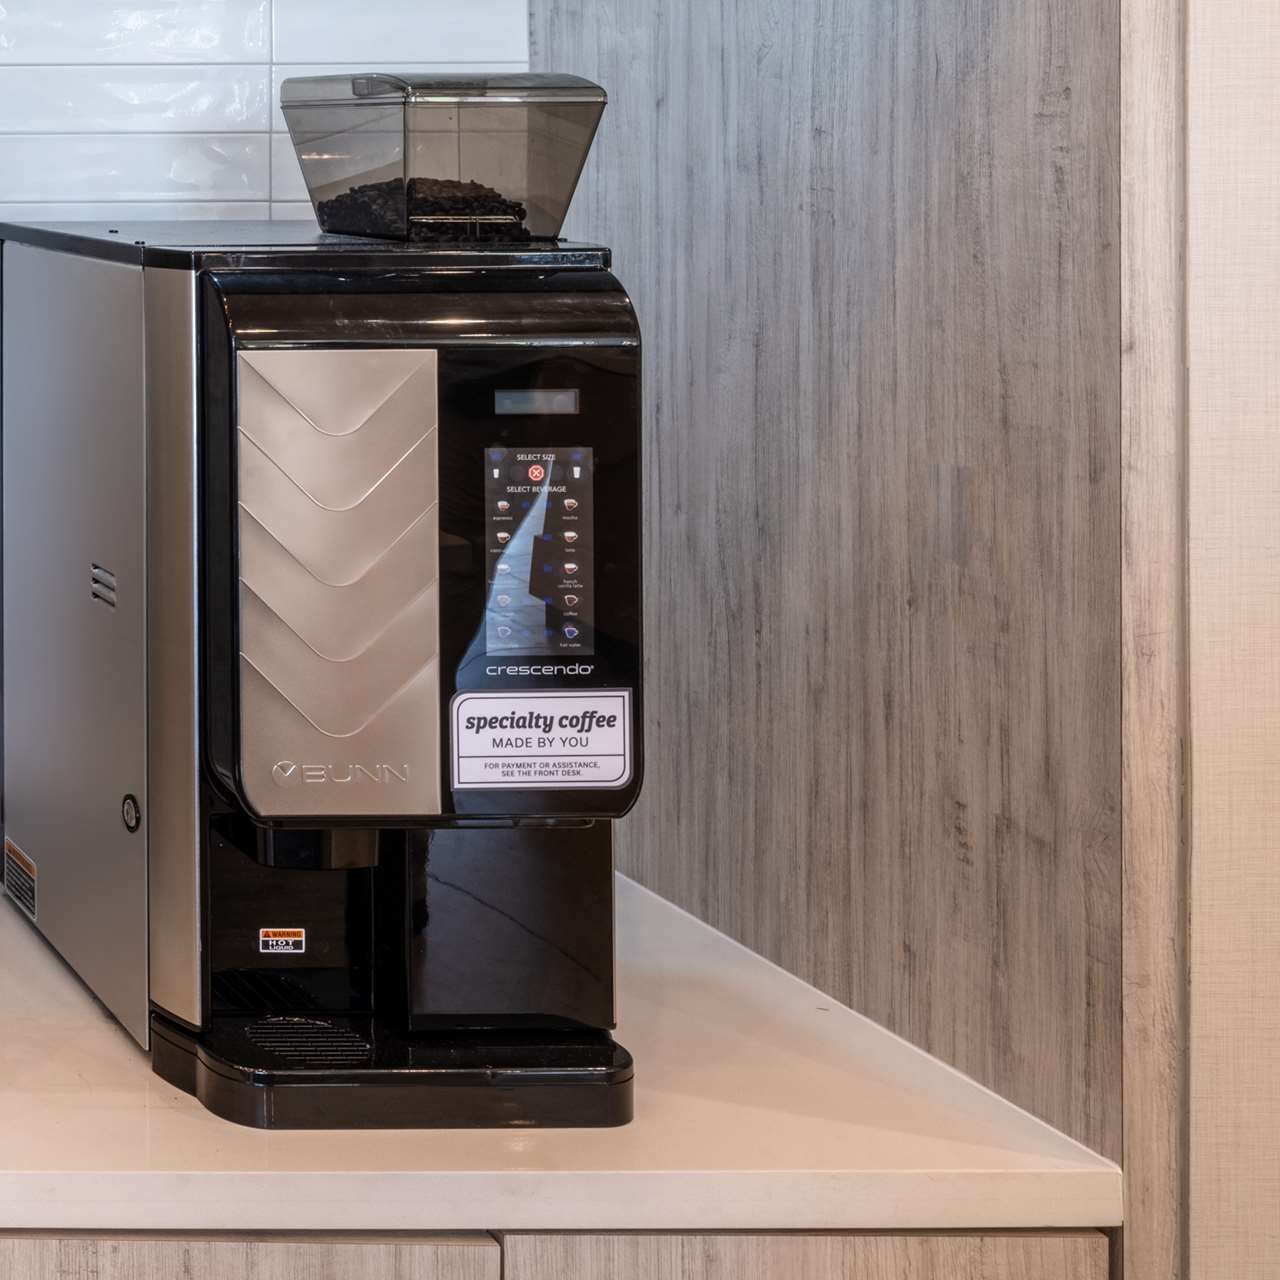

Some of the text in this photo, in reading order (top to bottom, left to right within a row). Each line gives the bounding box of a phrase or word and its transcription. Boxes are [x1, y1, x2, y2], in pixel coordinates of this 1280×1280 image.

[542, 453, 556, 461] SIZE
[531, 485, 567, 493] BEVERAGE
[486, 662, 591, 676] crescendo
[465, 711, 618, 734] specialty coffee
[492, 736, 590, 749] MADE BY YOU
[484, 762, 500, 770] FOR
[501, 762, 537, 770] PAYMENT
[552, 761, 601, 769] ASSISTANCE,
[302, 763, 409, 784] BUNN
